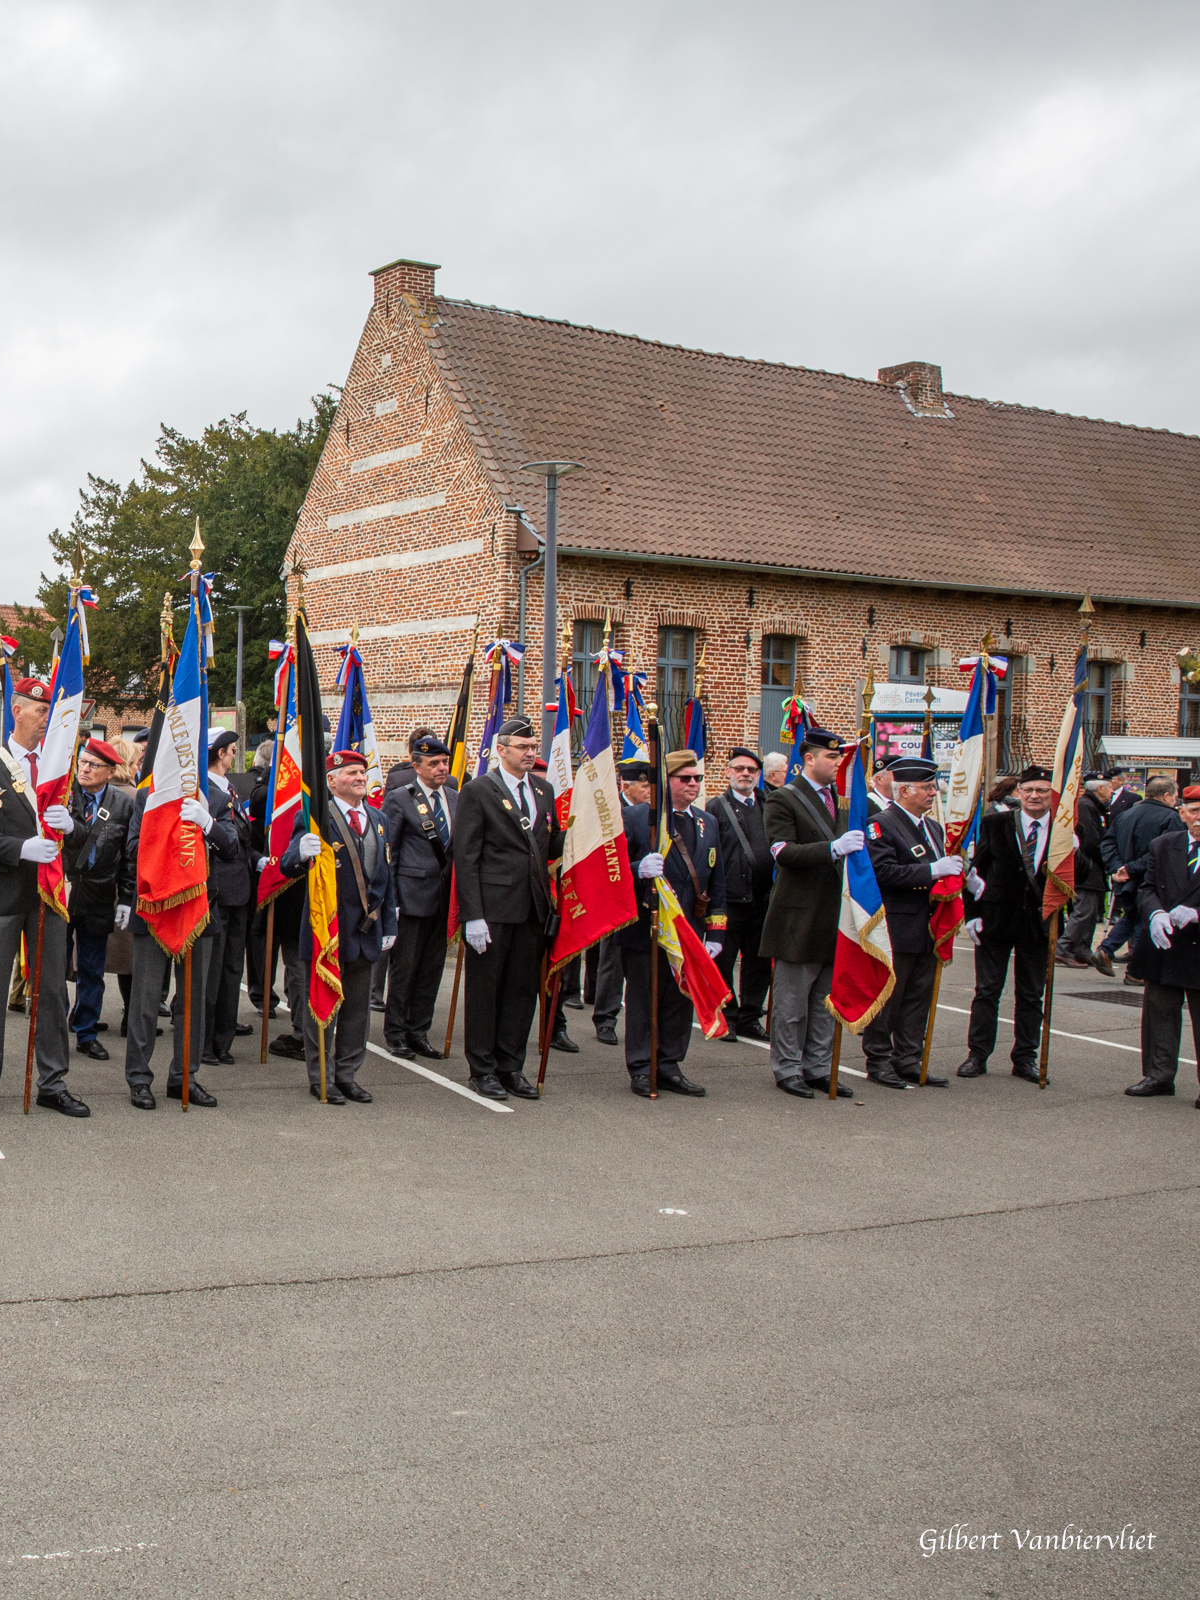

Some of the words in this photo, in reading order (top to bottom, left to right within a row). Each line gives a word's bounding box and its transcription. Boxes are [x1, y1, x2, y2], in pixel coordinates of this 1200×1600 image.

[175, 743, 196, 768] DES
[552, 747, 569, 829] NATIONALE
[593, 789, 622, 883] COMBATTANTS
